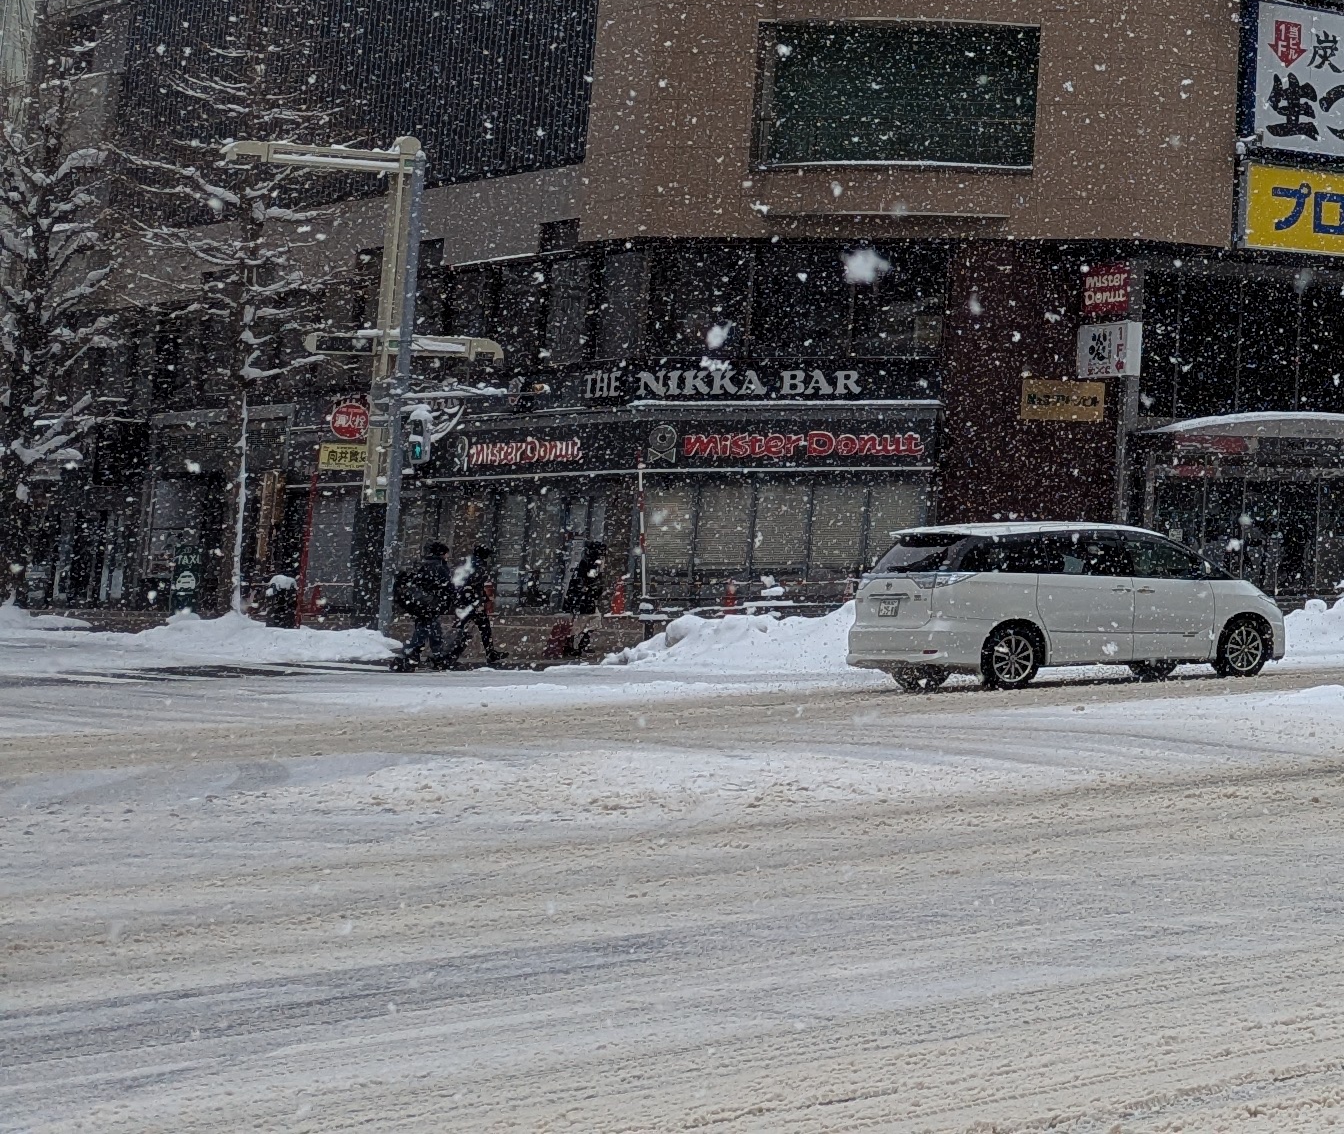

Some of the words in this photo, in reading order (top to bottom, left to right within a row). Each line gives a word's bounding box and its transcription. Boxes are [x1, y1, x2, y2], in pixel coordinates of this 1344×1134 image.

[1083, 288, 1127, 306] Donut
[583, 371, 622, 399] THE
[635, 369, 767, 397] NIKKA
[780, 369, 863, 396] BAR
[334, 414, 367, 429] 消火栓
[526, 436, 582, 463] Donut
[805, 430, 925, 457] Donut
